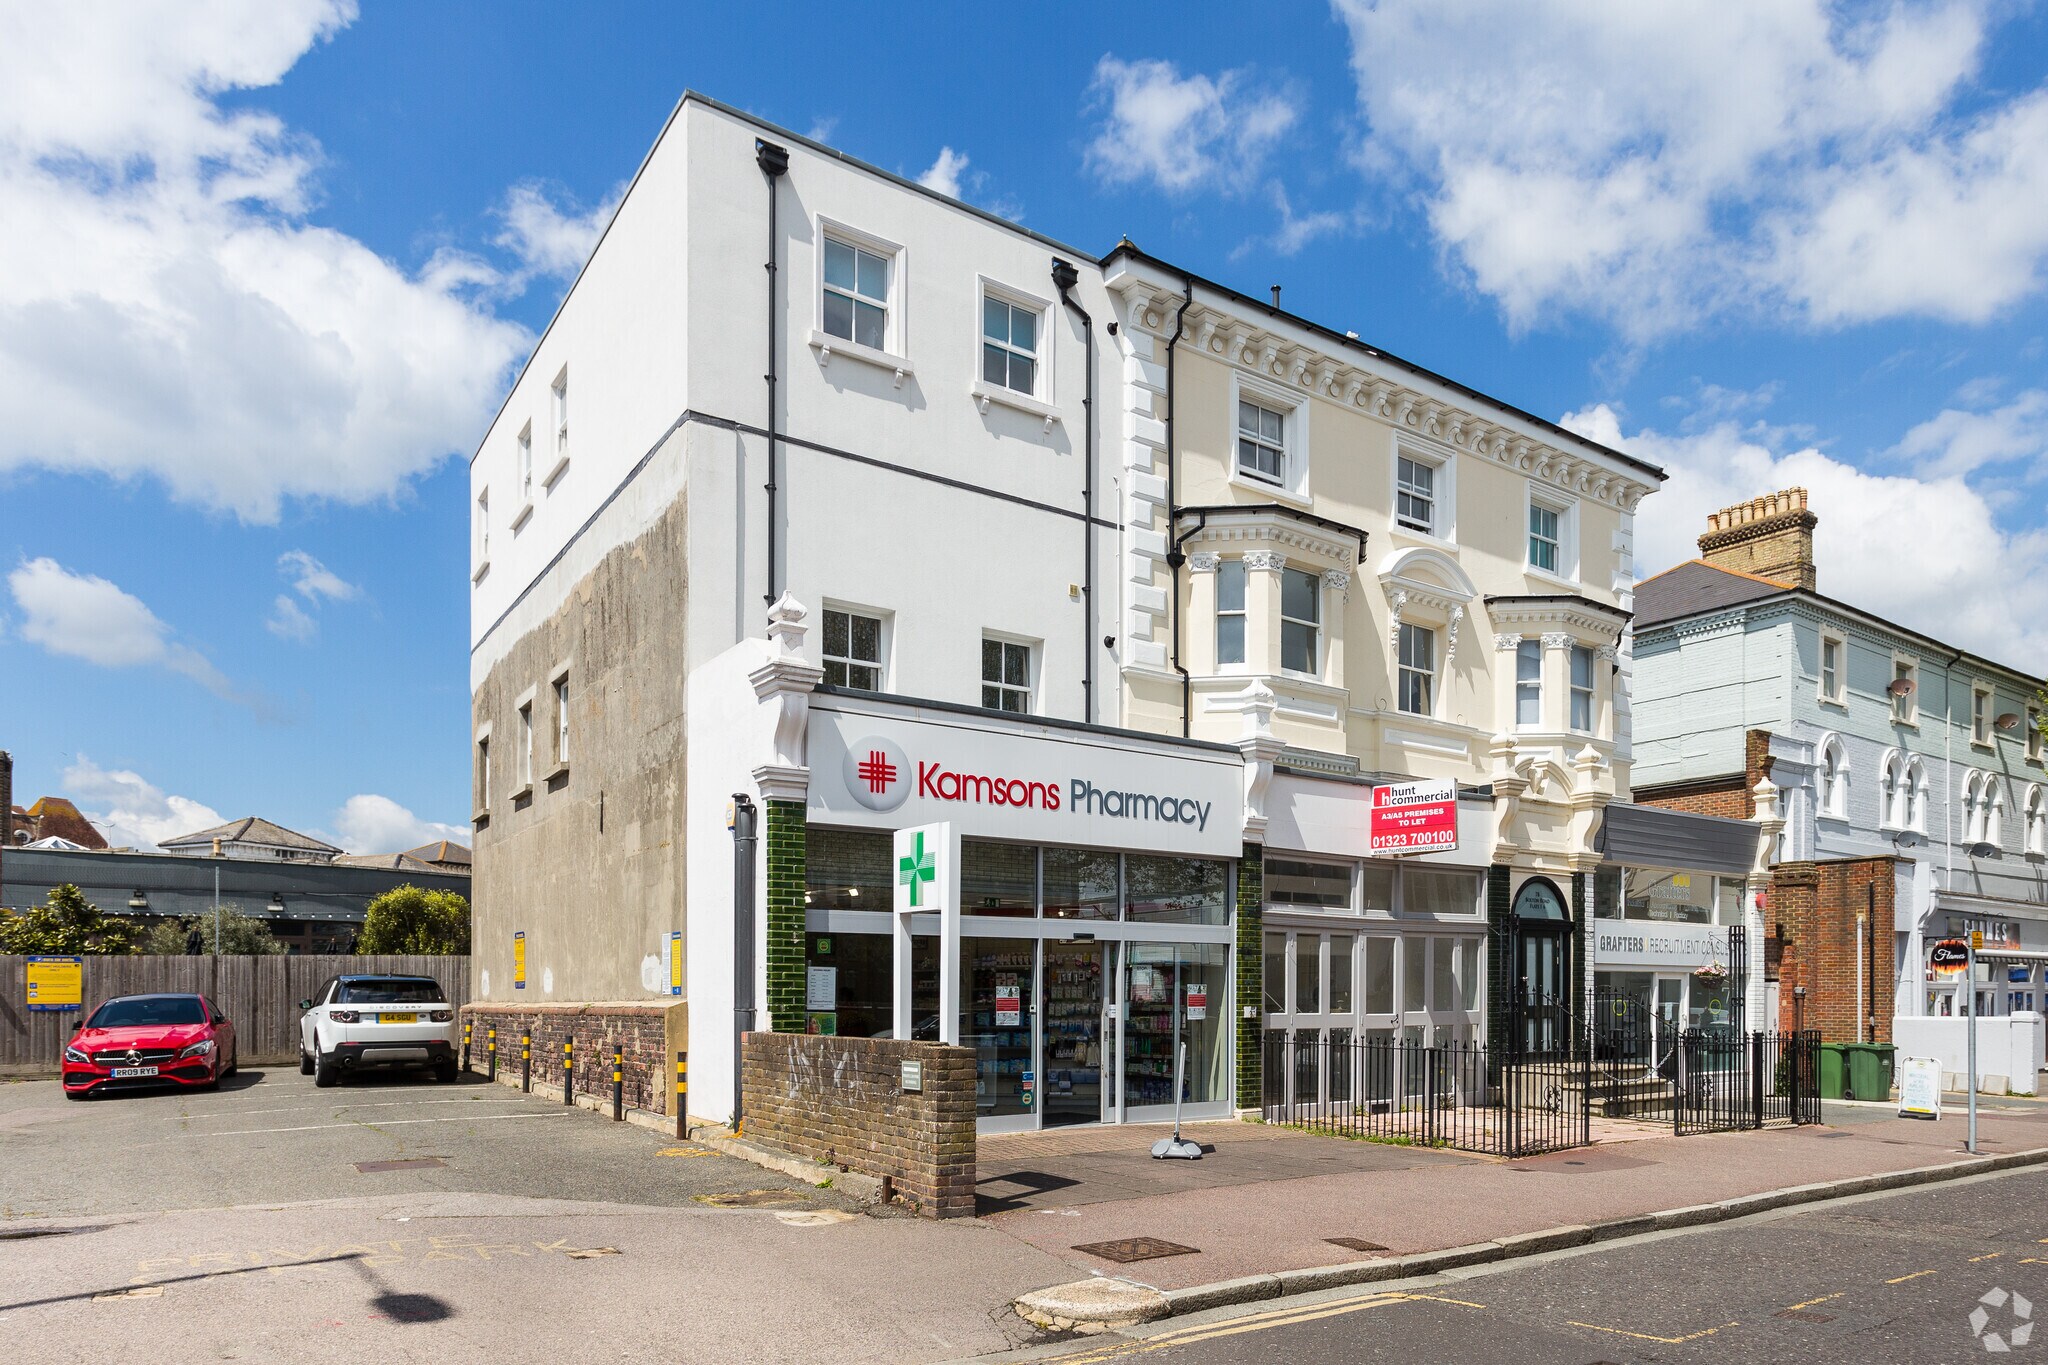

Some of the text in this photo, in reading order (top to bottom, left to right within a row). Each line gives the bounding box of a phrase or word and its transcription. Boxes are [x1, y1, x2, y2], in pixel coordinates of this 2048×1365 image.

[919, 760, 1212, 833] Kamsons Pharmacy
[1392, 786, 1416, 797] hunt
[1392, 789, 1453, 805] commercial
[1381, 808, 1444, 820] A3/A5 PREMISES
[1411, 818, 1426, 826] LET
[1373, 830, 1454, 848] 01323 700100
[1373, 844, 1453, 855] www.huntcommercial.co.uk
[1600, 935, 1644, 953] GRAFTERS
[1649, 938, 1700, 955] RECRUITMENT
[1934, 948, 1966, 961] Flames
[385, 1013, 395, 1021] G4
[116, 1067, 157, 1077] RR09 RYE
[138, 1233, 486, 1272] PRIVATE
